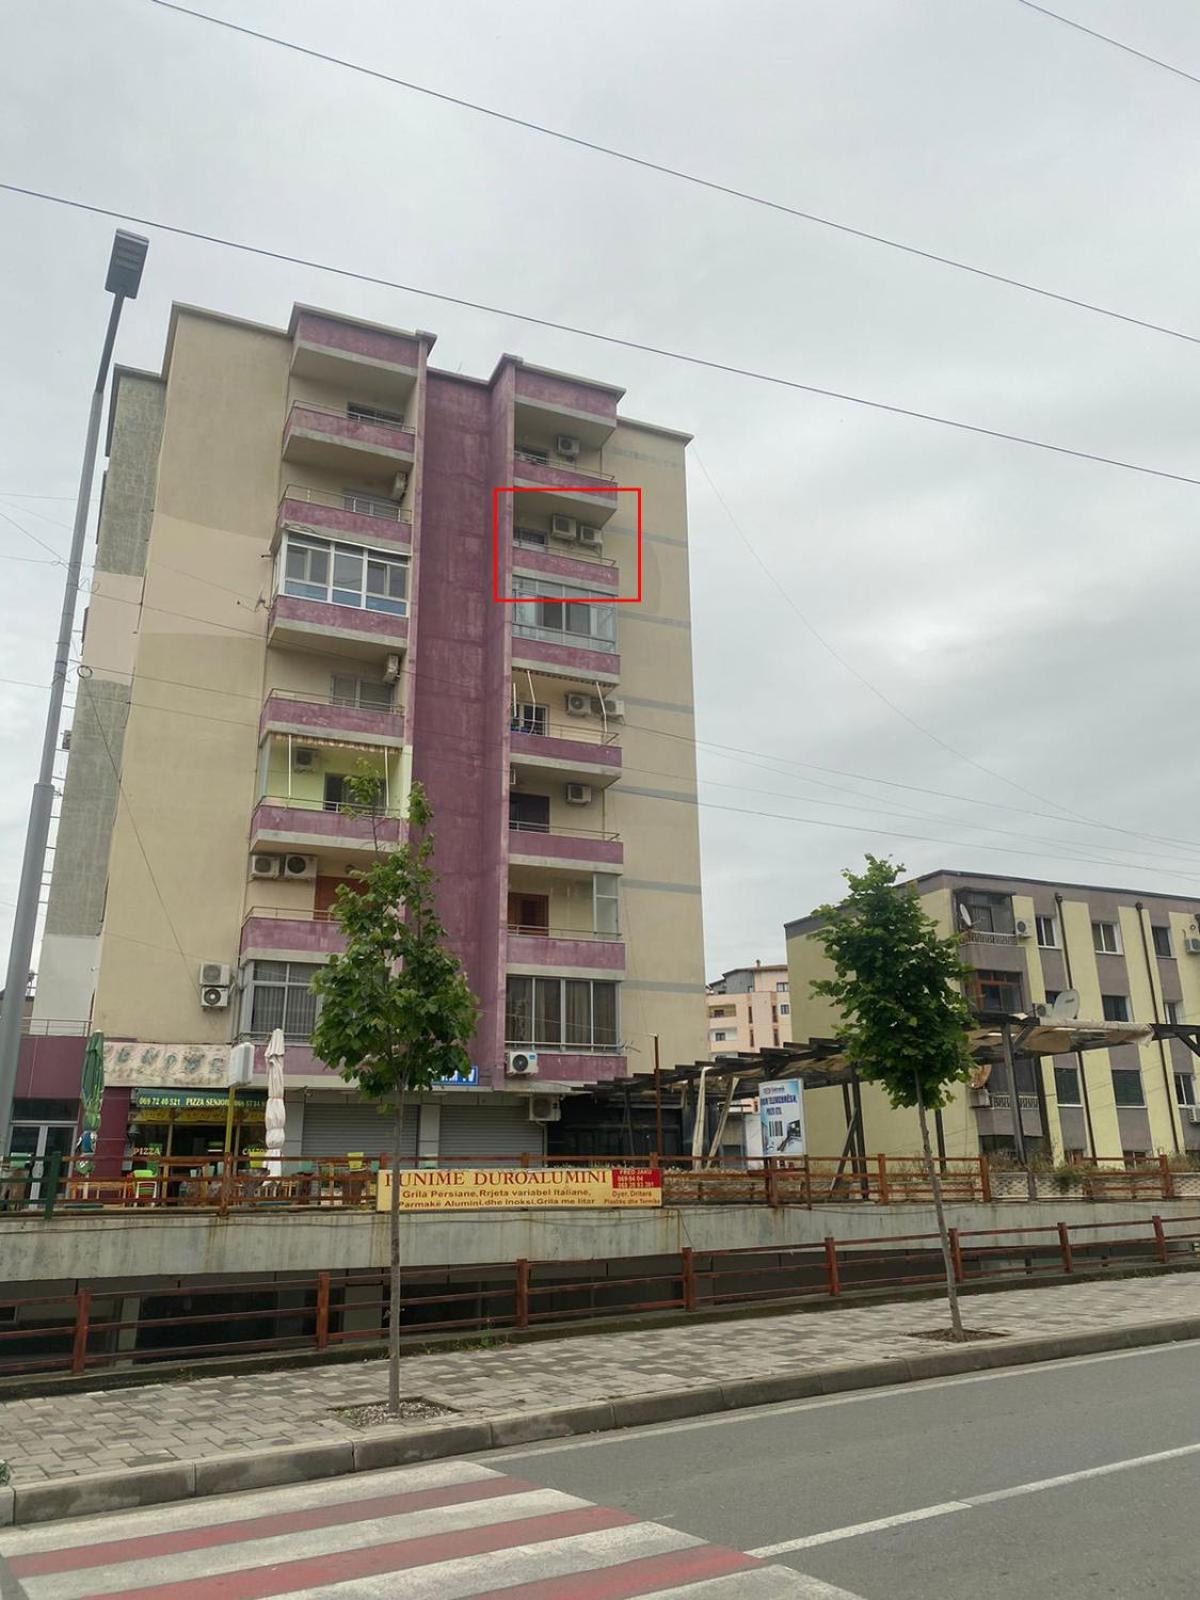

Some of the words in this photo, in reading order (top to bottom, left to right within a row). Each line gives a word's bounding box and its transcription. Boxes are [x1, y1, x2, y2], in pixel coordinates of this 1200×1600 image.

[185, 1097, 205, 1106] PIZZA
[132, 1147, 161, 1156] PIZZA
[473, 1170, 607, 1185] DUROALUMINI
